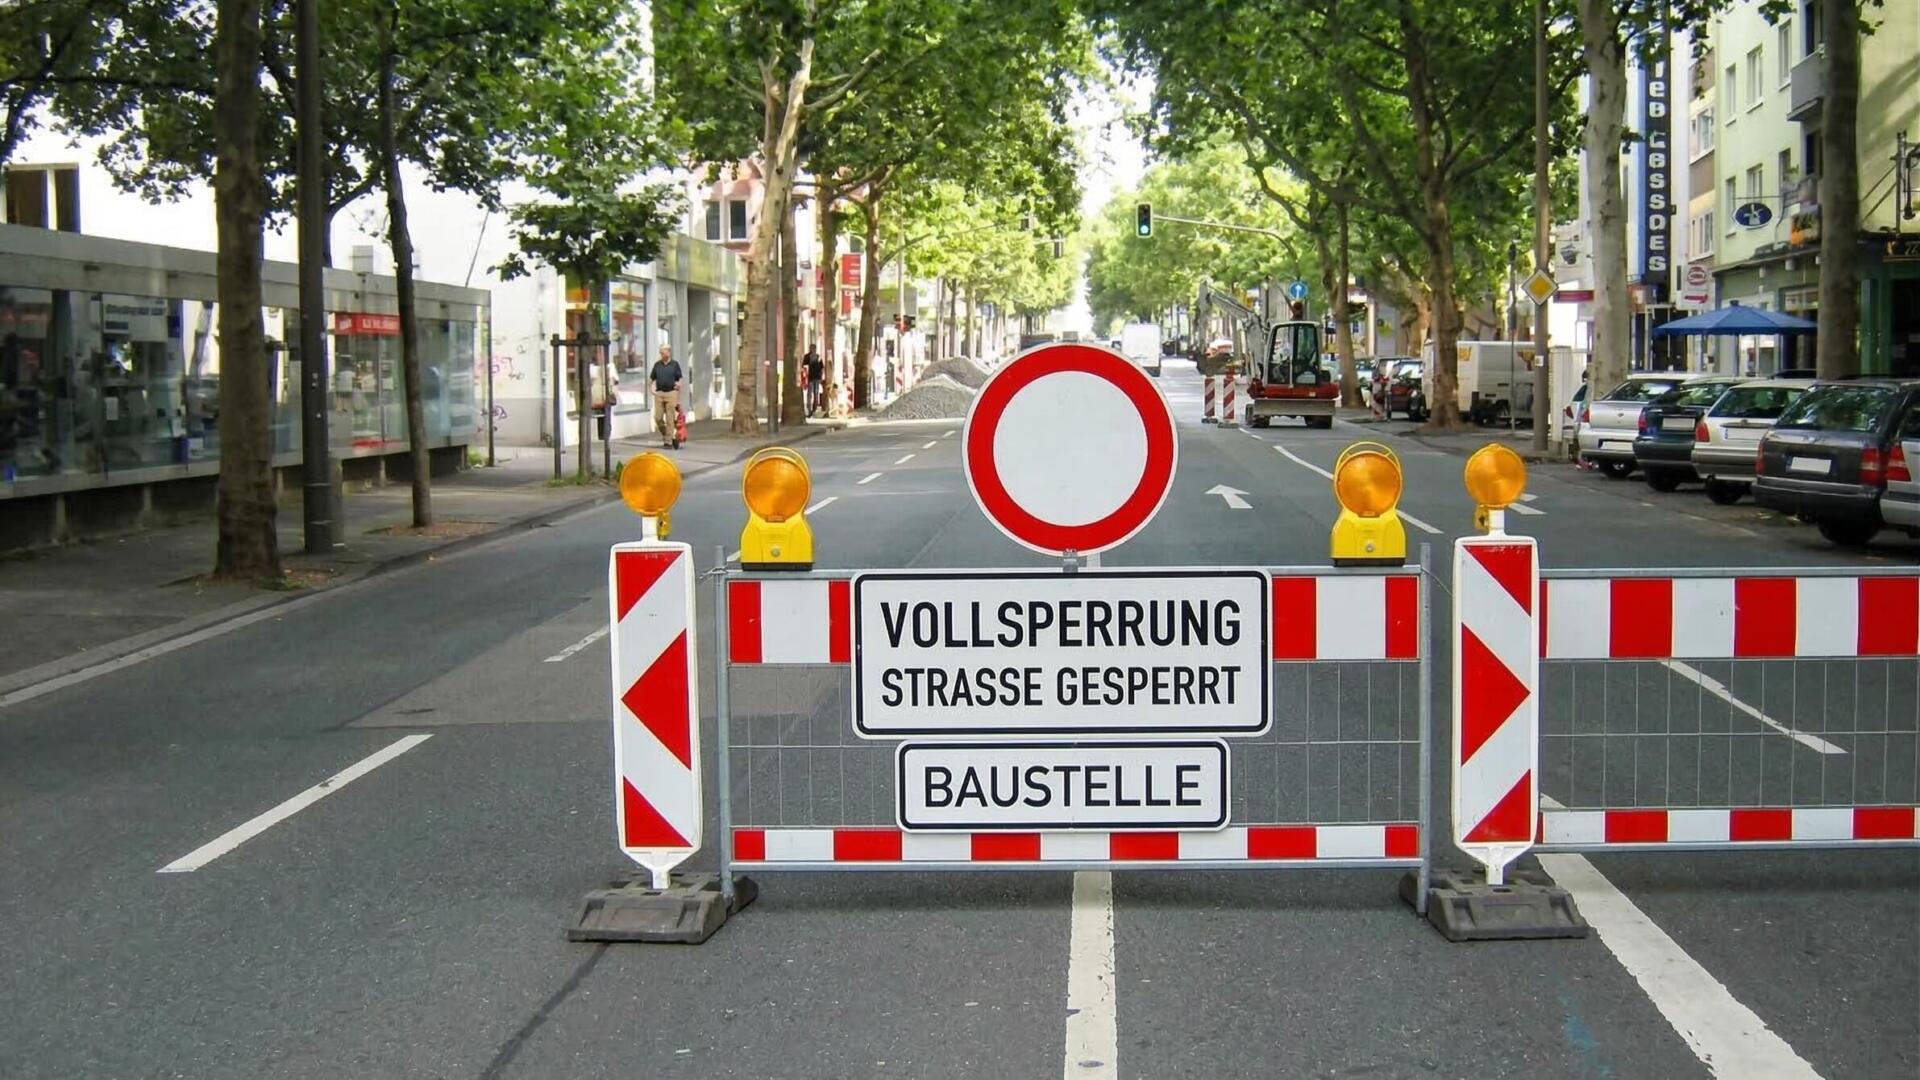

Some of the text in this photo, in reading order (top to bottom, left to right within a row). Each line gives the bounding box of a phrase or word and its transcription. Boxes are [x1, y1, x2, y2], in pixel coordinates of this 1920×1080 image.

[880, 599, 1241, 648] VOLLSPERRUNG
[881, 665, 1241, 707] STRASSE GESPERRT
[924, 764, 1202, 808] BAUSTELLE
